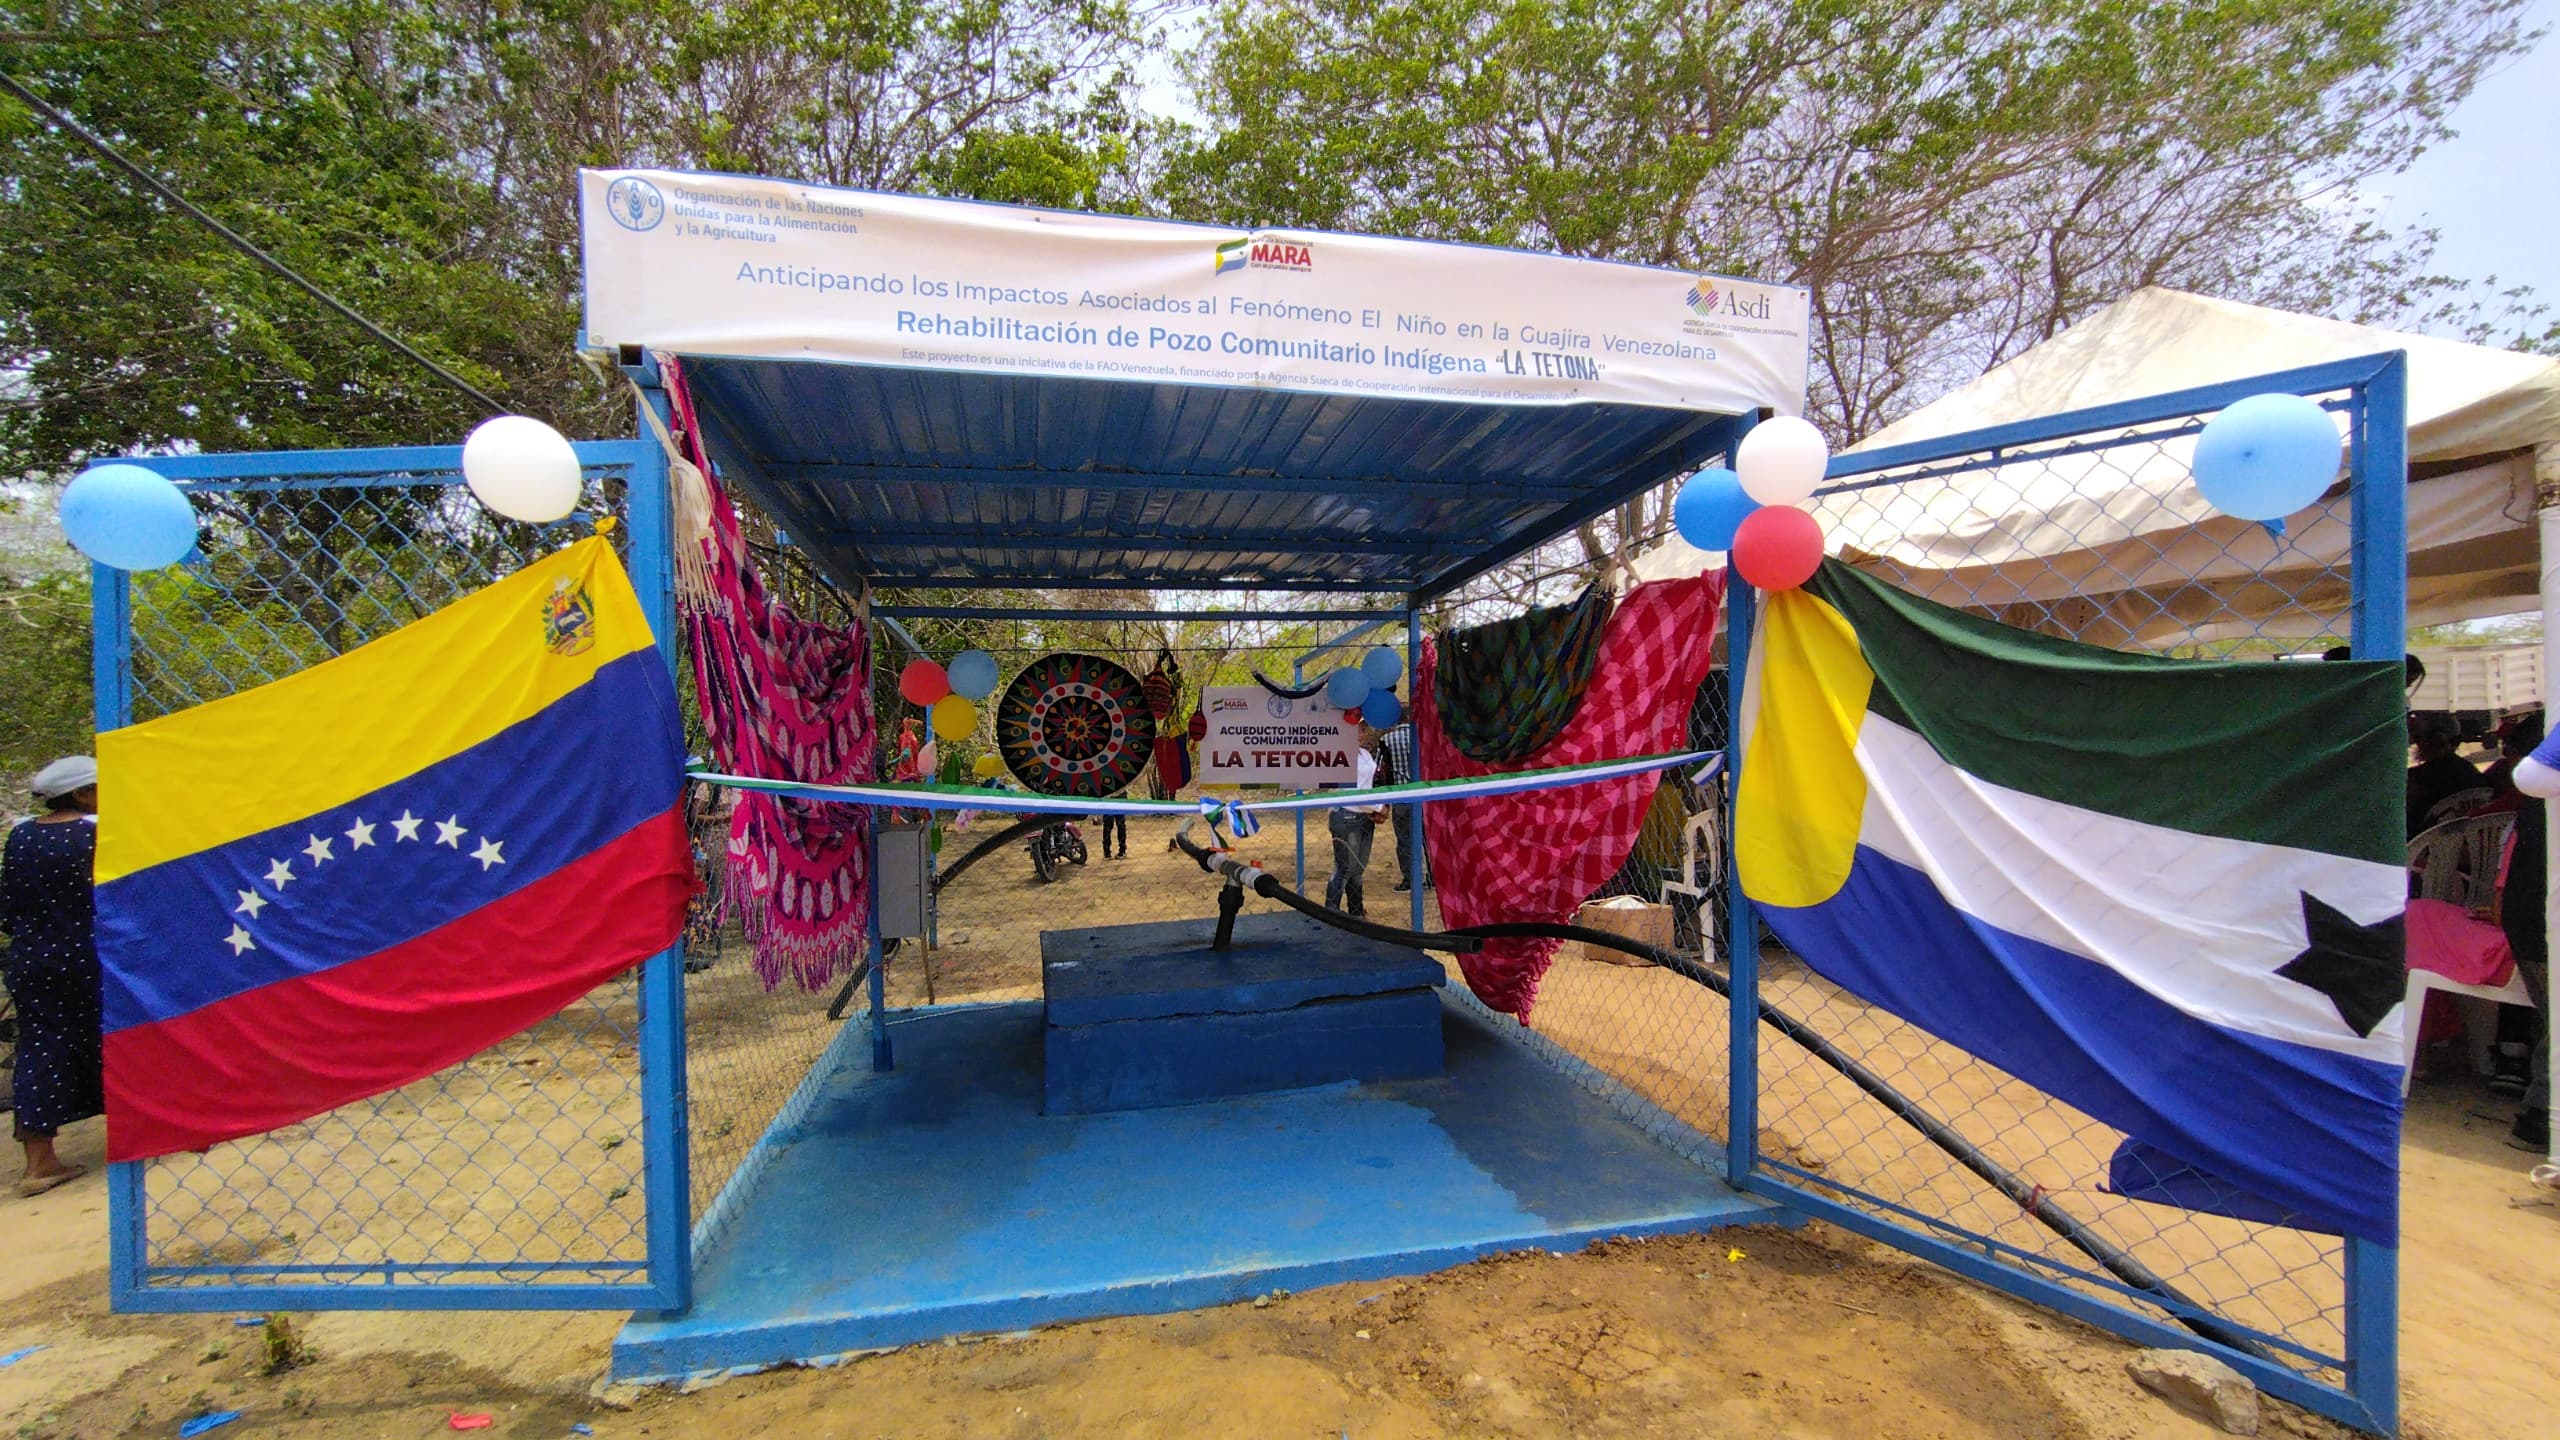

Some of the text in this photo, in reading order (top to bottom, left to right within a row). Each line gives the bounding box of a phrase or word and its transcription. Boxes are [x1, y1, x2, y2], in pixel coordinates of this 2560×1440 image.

[674, 187, 864, 218] Organización de las Naciones
[674, 203, 720, 220] Unidas
[724, 211, 754, 225] para
[758, 213, 771, 226] la
[774, 215, 858, 234] Alimentación
[675, 222, 776, 243] y la Agricultura
[1250, 243, 1312, 267] MARA
[736, 261, 1717, 361] Anticipando los Impactos Asociados al Fenómeno El Niño en la Guajira Venezolana
[1720, 289, 1771, 320] Asdi
[896, 310, 1097, 345] Rehabilitación
[1106, 324, 1140, 348] de
[1149, 327, 1212, 352] Pozo
[1220, 331, 1376, 366] Comunitario
[1384, 344, 1487, 375] Indígena
[901, 347, 926, 360] Este
[928, 351, 978, 364] proyecto
[980, 356, 993, 365] es
[995, 357, 1015, 368] una
[1018, 356, 1066, 370] iniciativa
[1069, 359, 1083, 371] de
[1085, 359, 1095, 372] la
[1097, 360, 1119, 373] FAO
[1121, 362, 1178, 377] Venezuela,
[1179, 365, 1235, 379] financiado
[1268, 370, 1308, 385] Agencia
[1310, 374, 1339, 387] Sueca
[1341, 375, 1354, 388] de
[1356, 377, 1416, 393] Cooperación
[1418, 380, 1479, 397] Internacional
[1220, 723, 1340, 736] ACUEDUCTO INDÍGENA
[1243, 735, 1319, 746] COMUNITARIO
[1212, 750, 1350, 769] LA TETONA
